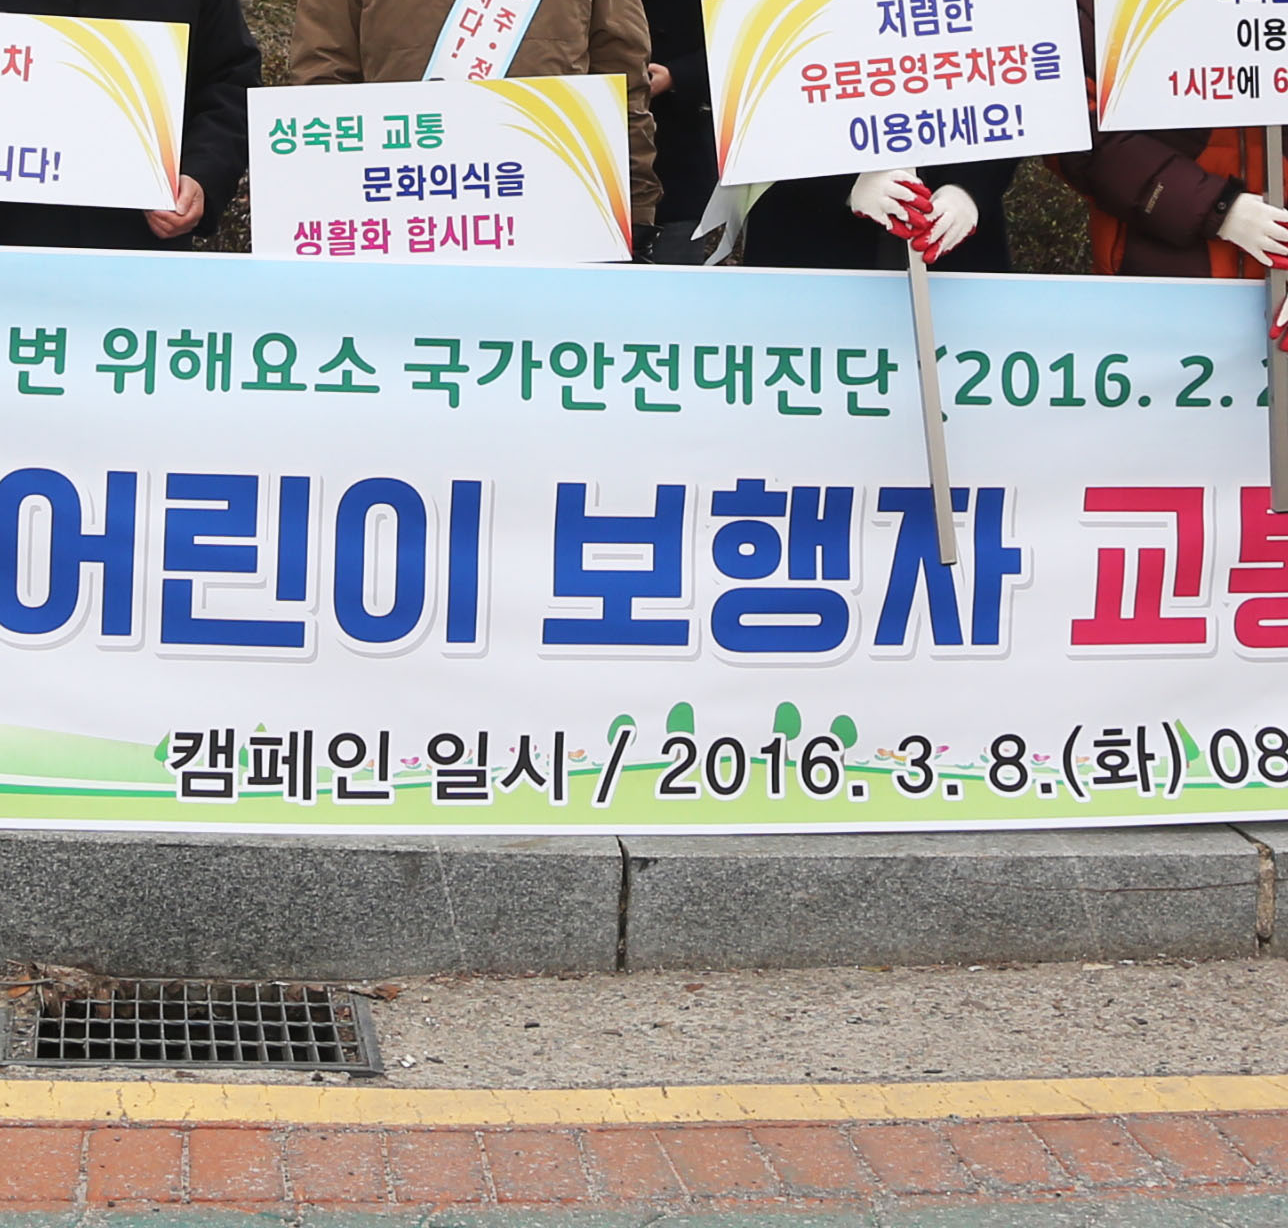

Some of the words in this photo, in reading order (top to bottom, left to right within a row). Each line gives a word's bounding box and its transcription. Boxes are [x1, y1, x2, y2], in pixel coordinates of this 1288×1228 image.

[799, 40, 1062, 105] 유료공영주차장을
[1167, 65, 1261, 101] 1시간에
[268, 114, 365, 156] 성숙된
[381, 112, 446, 151] 교통
[848, 102, 1026, 156] 이용하세요!
[361, 160, 526, 203] 문화의식을
[292, 216, 392, 257] 생활화
[406, 212, 515, 254] 합시다!
[95, 324, 380, 396] 위해요소
[403, 335, 899, 419] 국가안전대진단
[541, 477, 1022, 654] 보행자
[170, 727, 393, 802] 캠페인
[427, 728, 566, 803] 일시
[659, 735, 866, 798] 2016.
